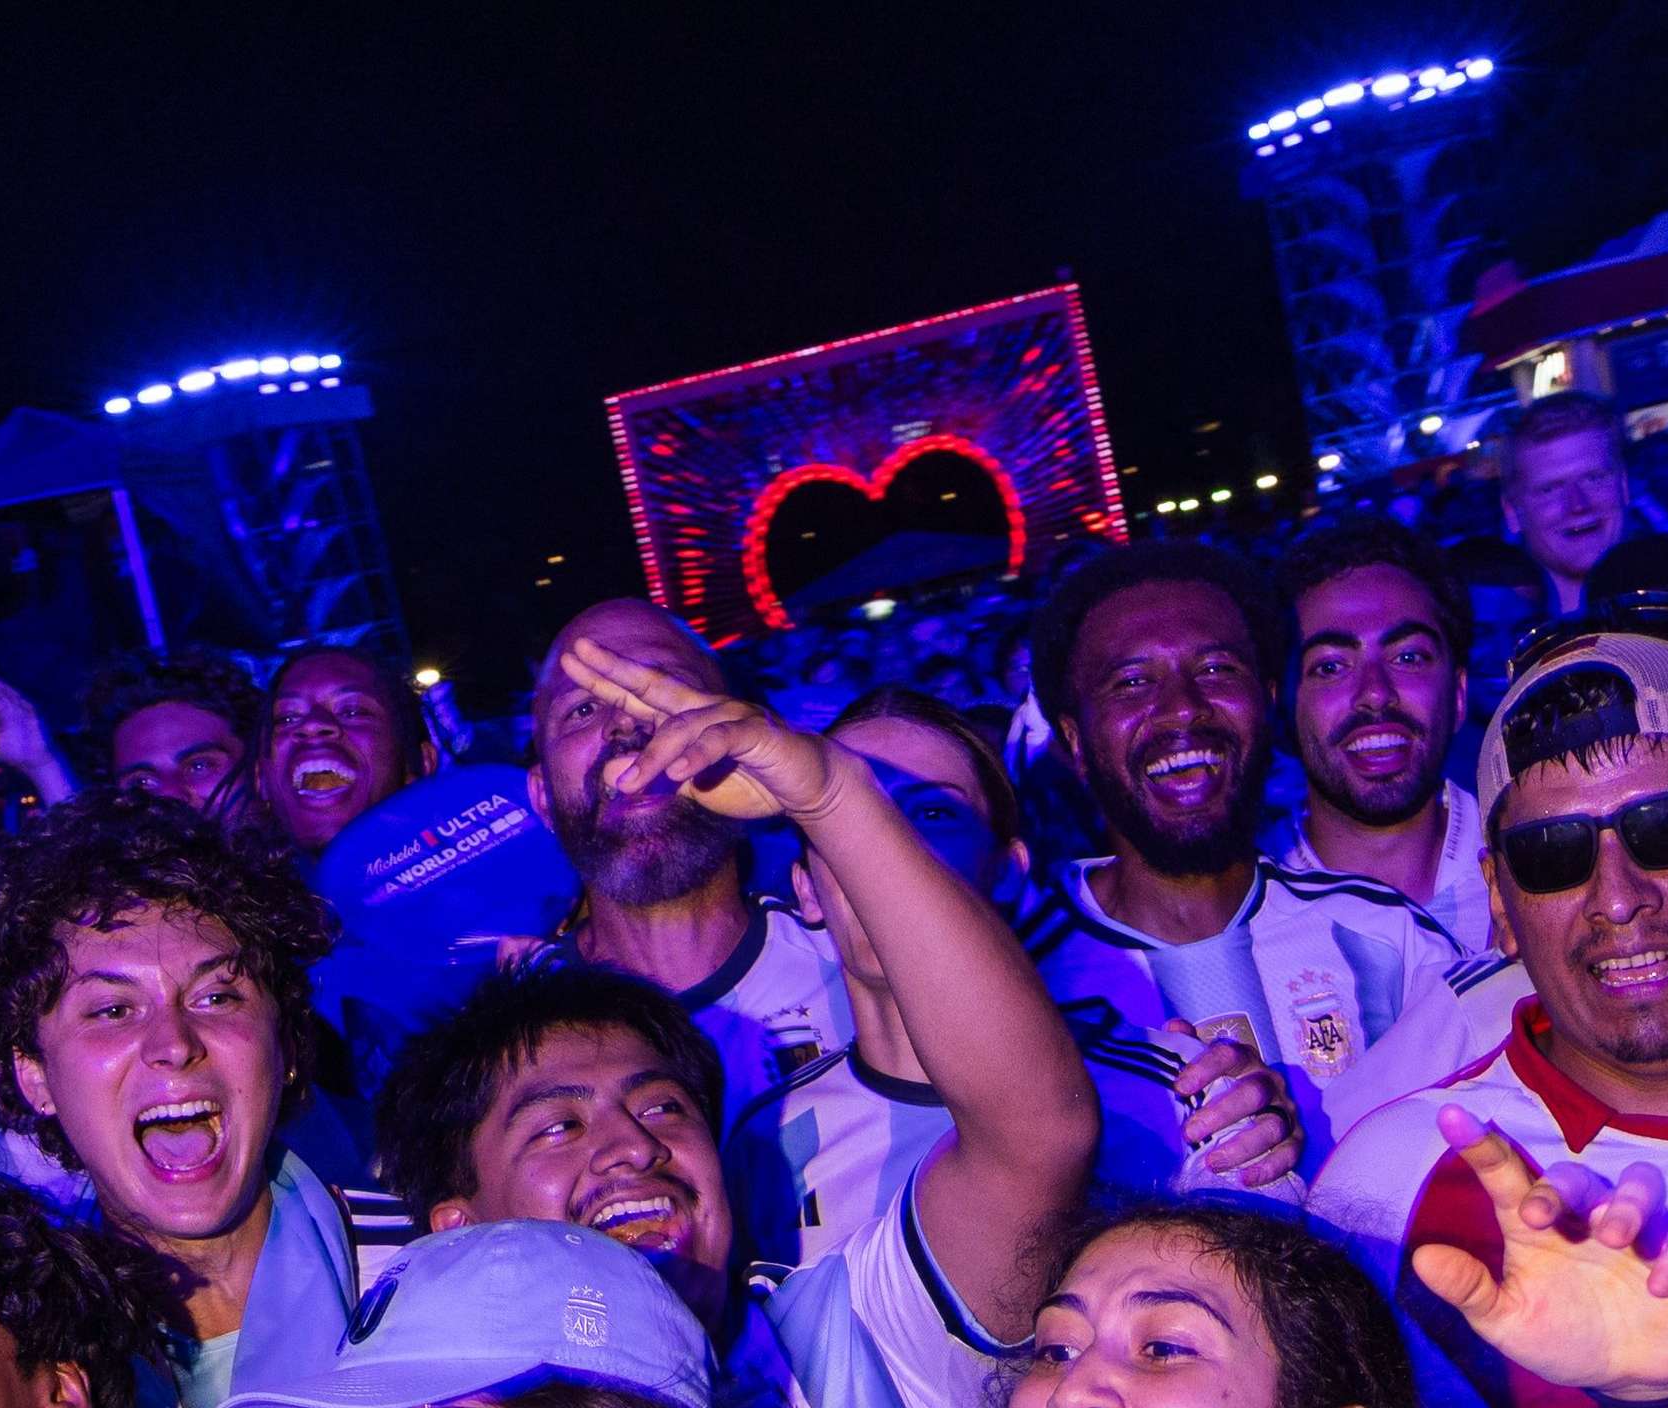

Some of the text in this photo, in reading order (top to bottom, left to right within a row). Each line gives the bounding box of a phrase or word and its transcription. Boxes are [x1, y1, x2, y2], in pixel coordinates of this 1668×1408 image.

[366, 839, 422, 876] Michelob
[436, 793, 509, 838] ULTRA
[395, 847, 458, 885] WORLD
[456, 827, 491, 853] CUP
[1307, 1013, 1344, 1052] AFA
